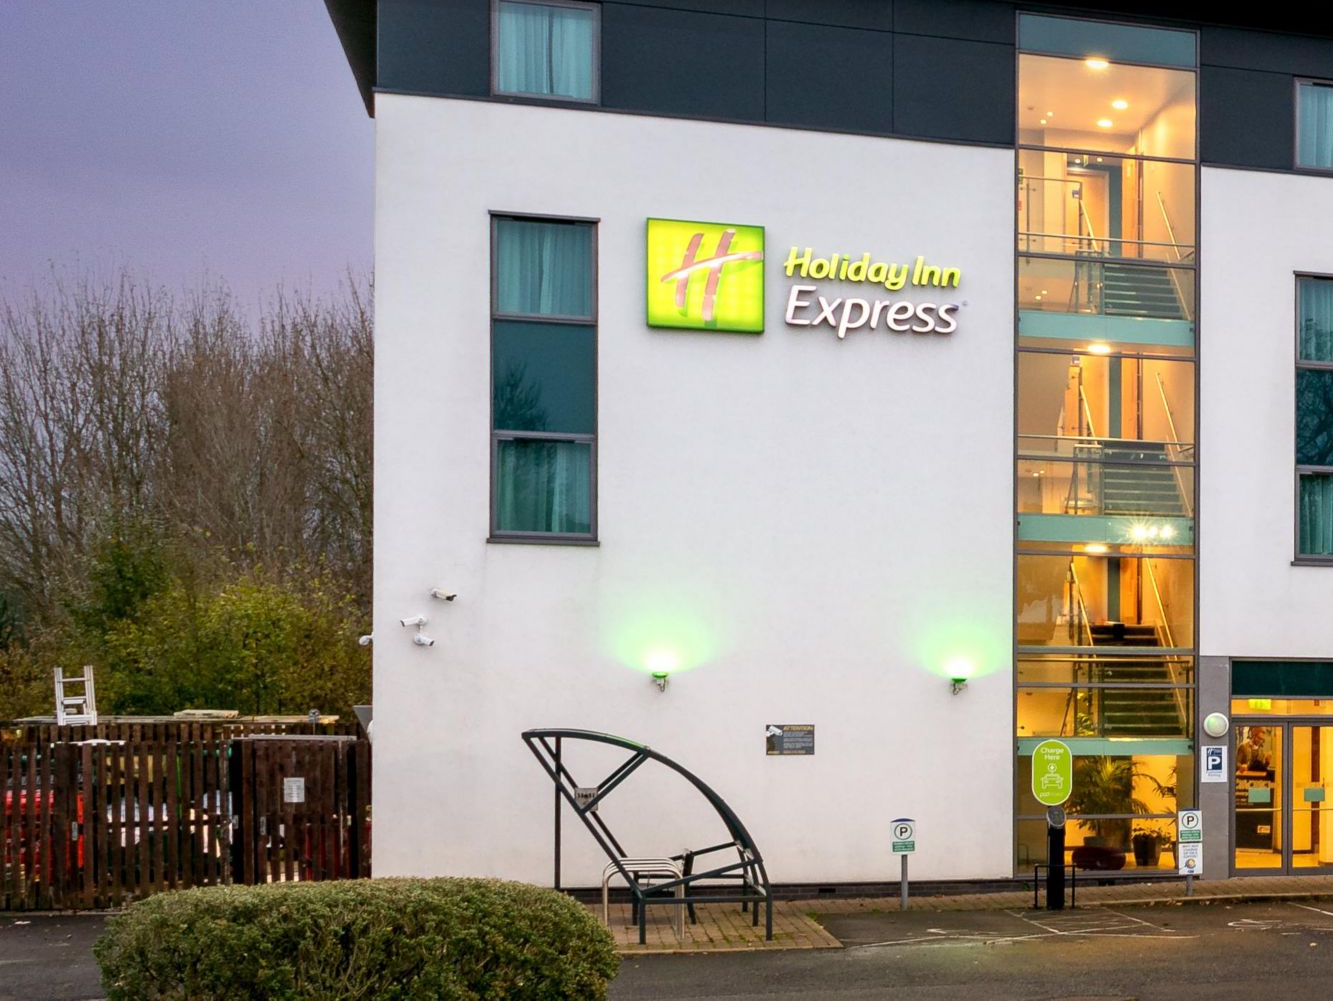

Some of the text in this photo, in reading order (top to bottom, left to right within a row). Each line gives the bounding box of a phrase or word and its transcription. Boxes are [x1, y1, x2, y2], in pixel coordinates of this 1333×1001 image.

[783, 246, 961, 291] Holiday Inn
[784, 284, 960, 339] Express
[1040, 747, 1065, 755] Charge
[1208, 756, 1221, 771] P
[1186, 815, 1195, 826] P
[899, 826, 908, 837] P
